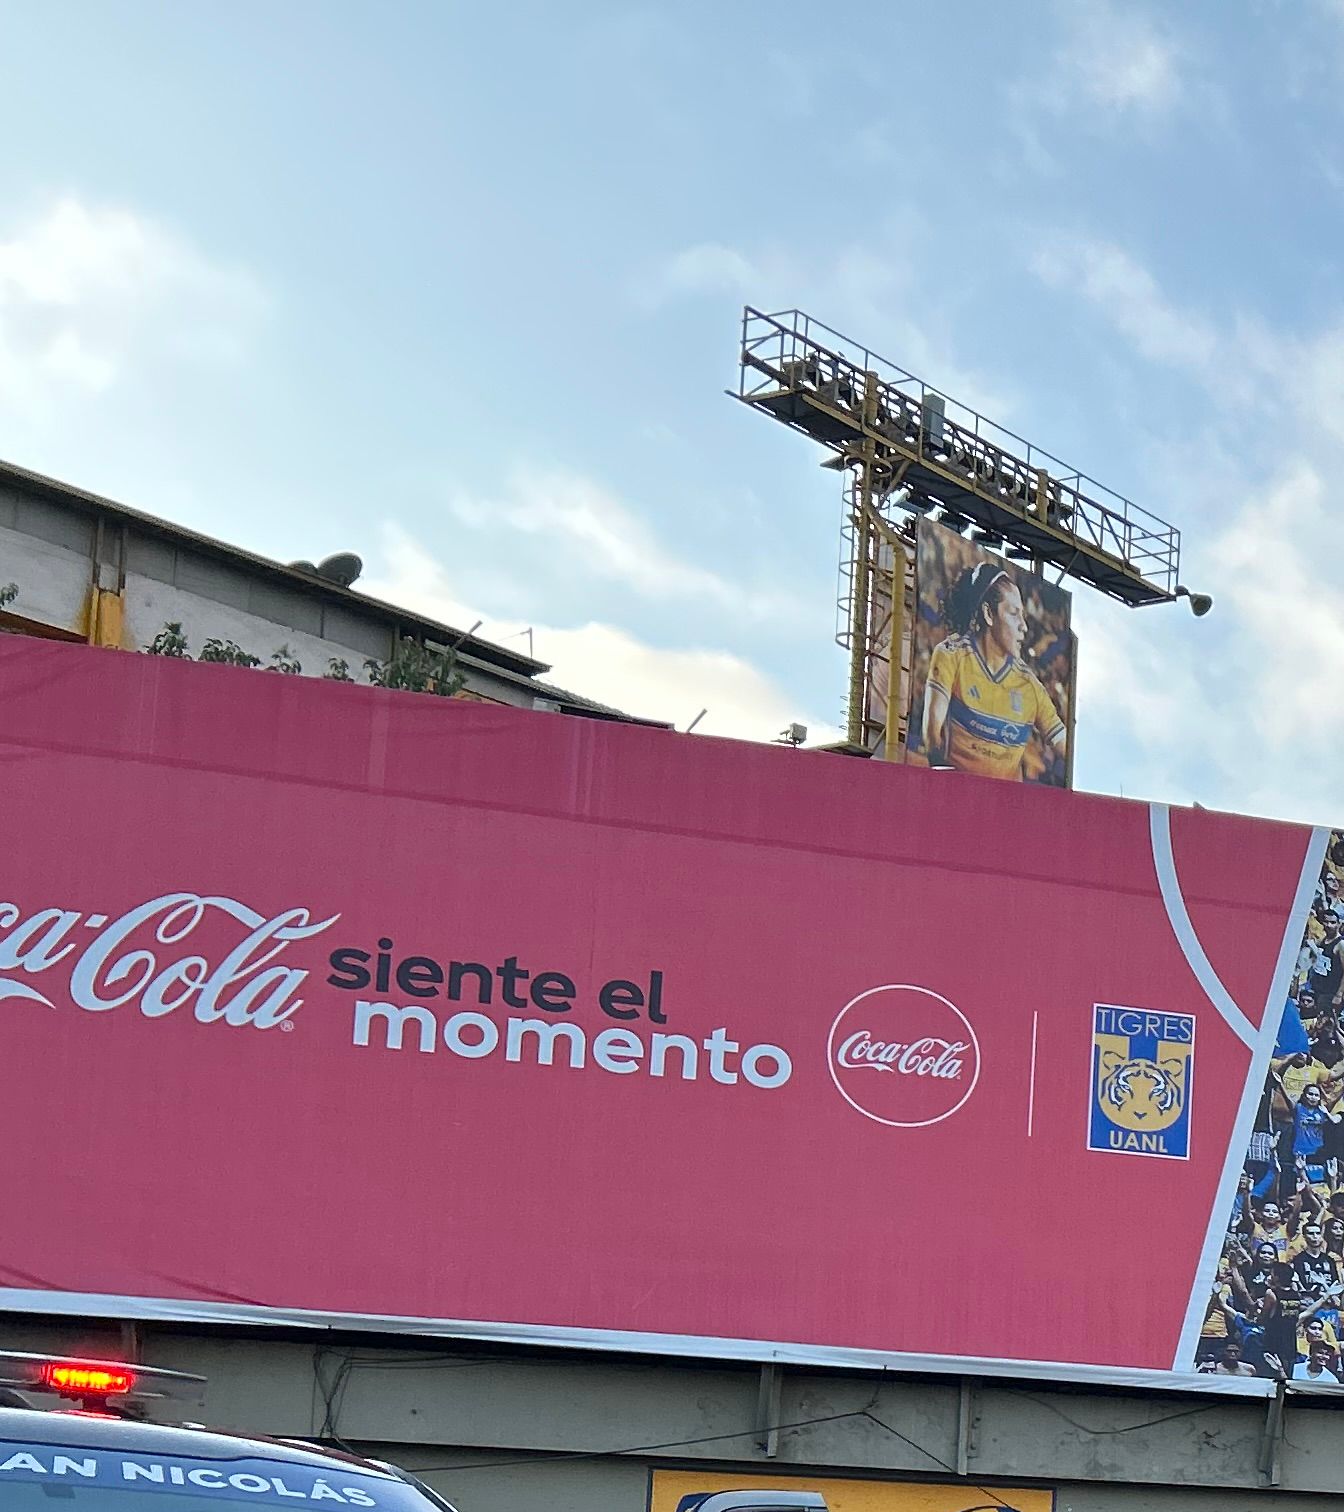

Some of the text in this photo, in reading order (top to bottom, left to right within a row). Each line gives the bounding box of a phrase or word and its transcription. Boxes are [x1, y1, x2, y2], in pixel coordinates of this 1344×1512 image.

[326, 937, 668, 1025] siente el
[352, 1000, 793, 1089] momento
[1097, 1008, 1192, 1042] TIGRES
[837, 1030, 972, 1080] Coca-Cola
[1109, 1130, 1169, 1154] UANL
[122, 1461, 377, 1507] NICOLÁS
